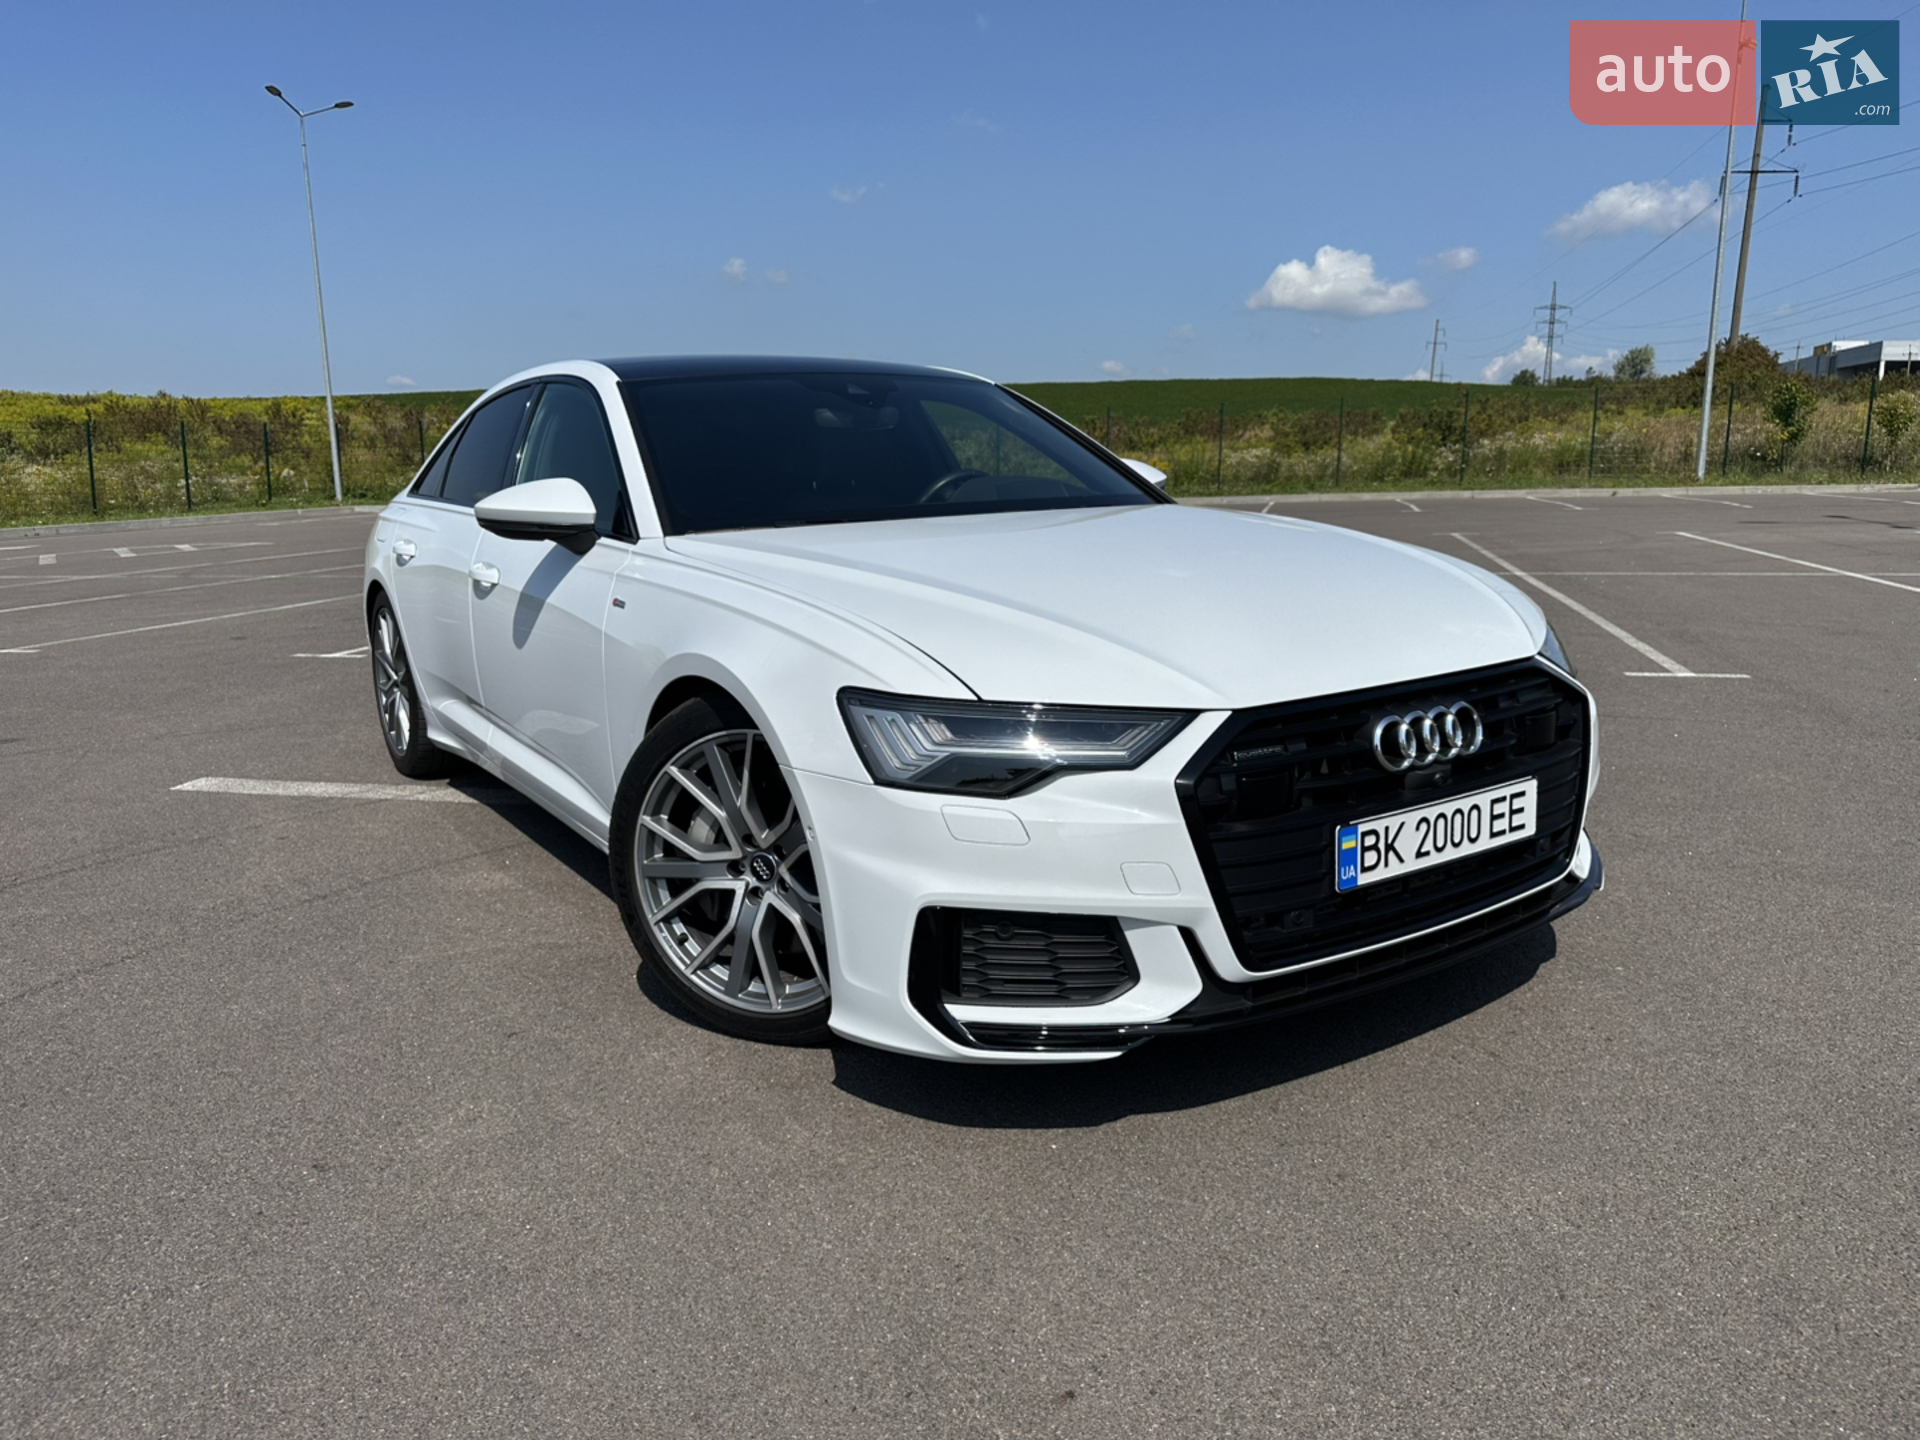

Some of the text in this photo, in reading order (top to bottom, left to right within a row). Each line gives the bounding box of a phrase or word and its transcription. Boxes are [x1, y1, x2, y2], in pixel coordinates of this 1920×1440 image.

[1360, 790, 1526, 874] BK 2000 EE
[1341, 865, 1356, 880] UA
